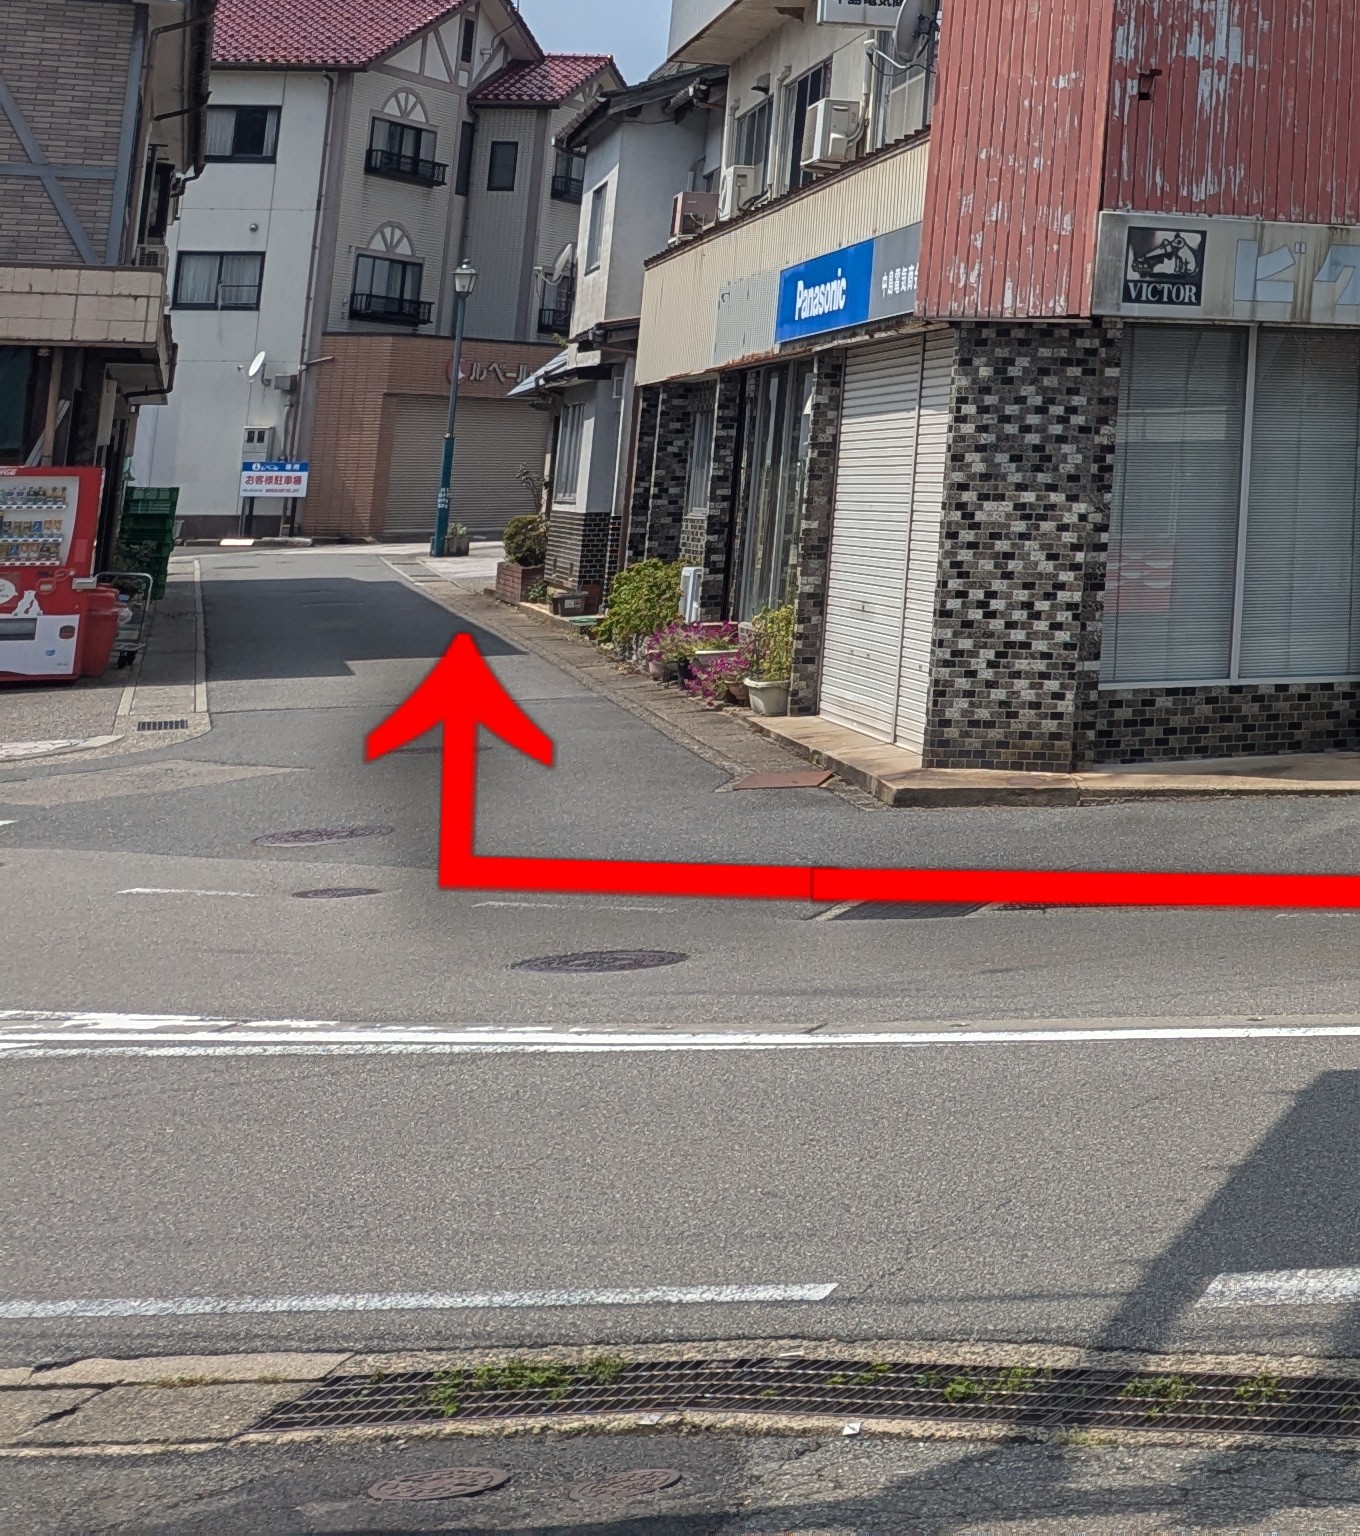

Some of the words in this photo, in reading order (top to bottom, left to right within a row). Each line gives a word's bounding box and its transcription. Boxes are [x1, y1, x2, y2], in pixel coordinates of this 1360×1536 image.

[795, 267, 847, 321] Panasonic
[1127, 282, 1198, 304] VICTOR
[244, 475, 303, 486] お客様駐車場
